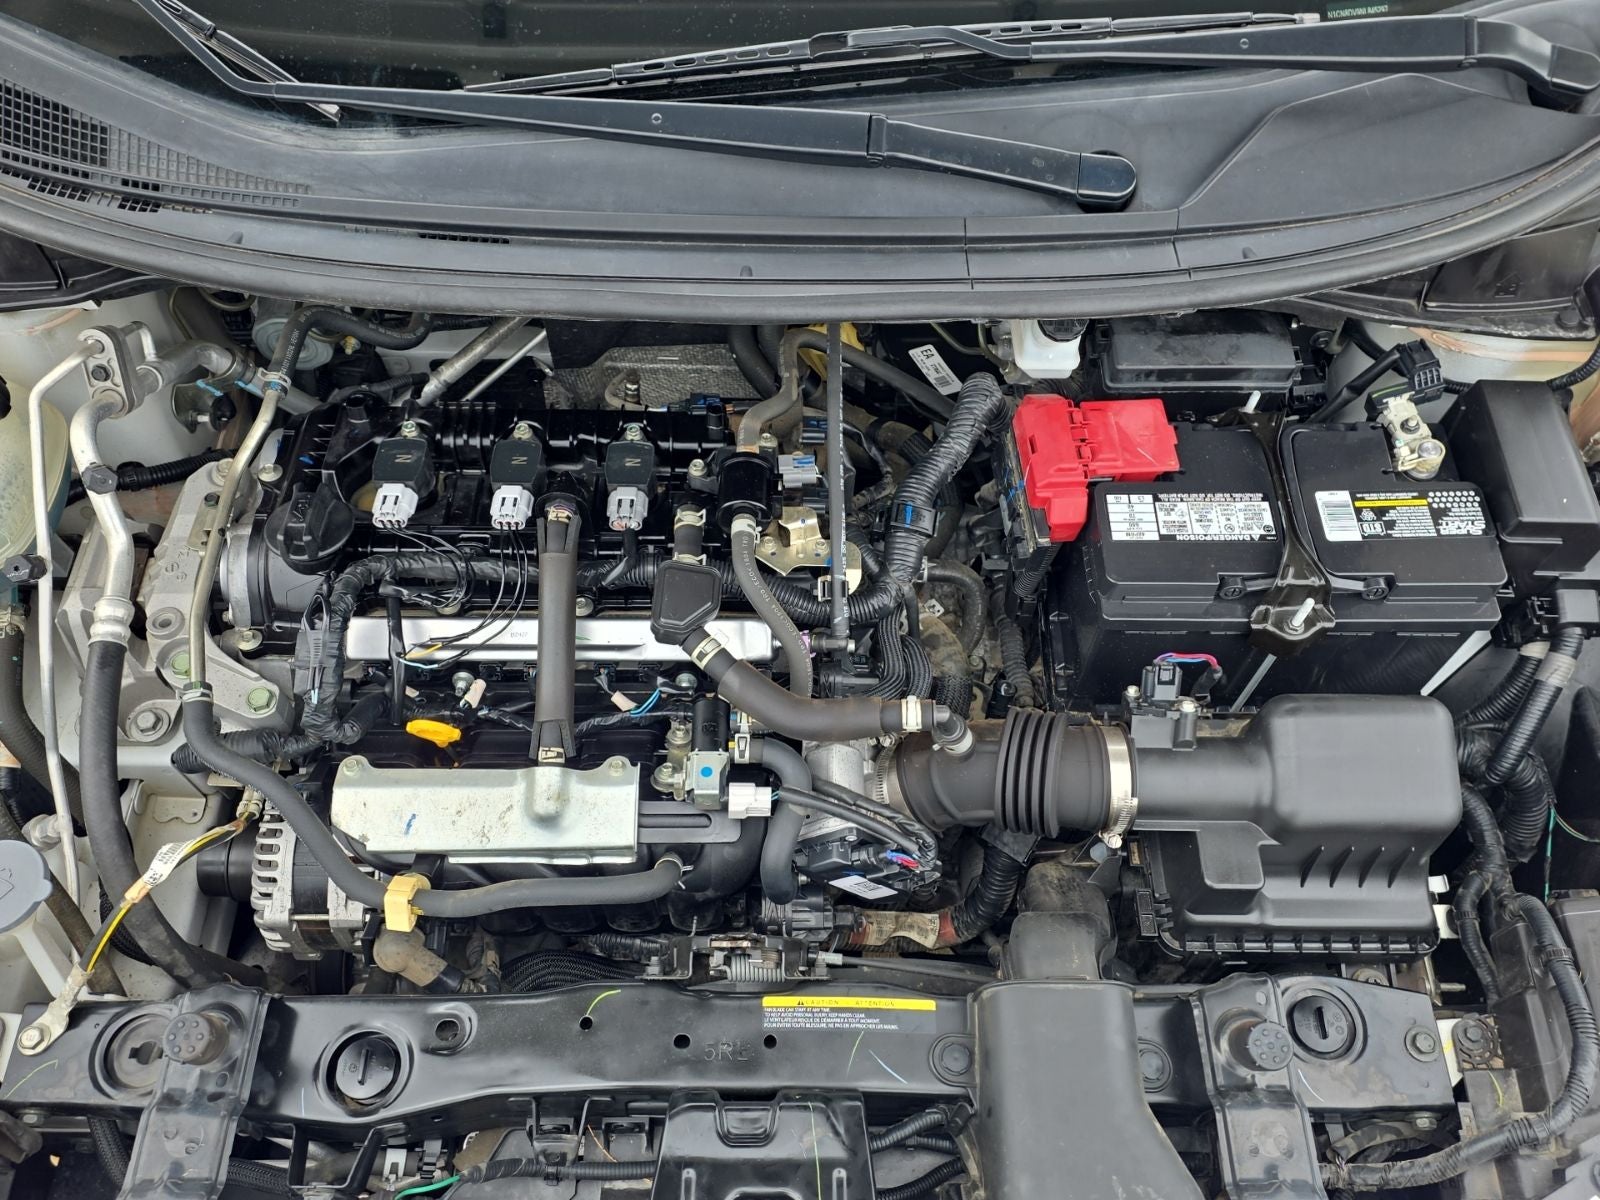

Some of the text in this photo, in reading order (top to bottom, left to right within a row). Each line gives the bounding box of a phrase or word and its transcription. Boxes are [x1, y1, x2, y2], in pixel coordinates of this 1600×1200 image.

[920, 348, 935, 360] EA
[1438, 520, 1486, 529] START
[1440, 528, 1483, 536] SUPER
